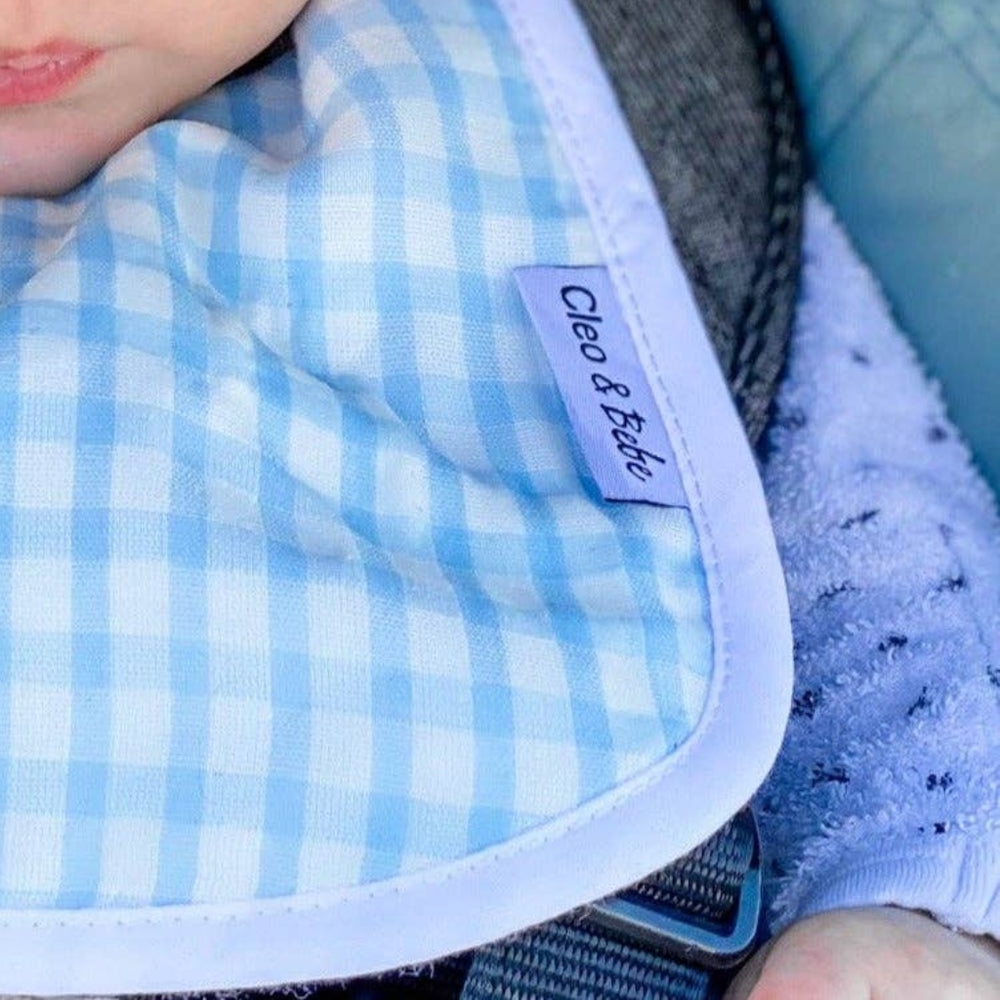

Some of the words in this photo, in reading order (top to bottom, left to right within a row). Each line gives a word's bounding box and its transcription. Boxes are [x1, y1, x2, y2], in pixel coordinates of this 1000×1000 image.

[560, 284, 607, 363] Cleo
[591, 373, 630, 398] &
[600, 403, 666, 482] Bebe
